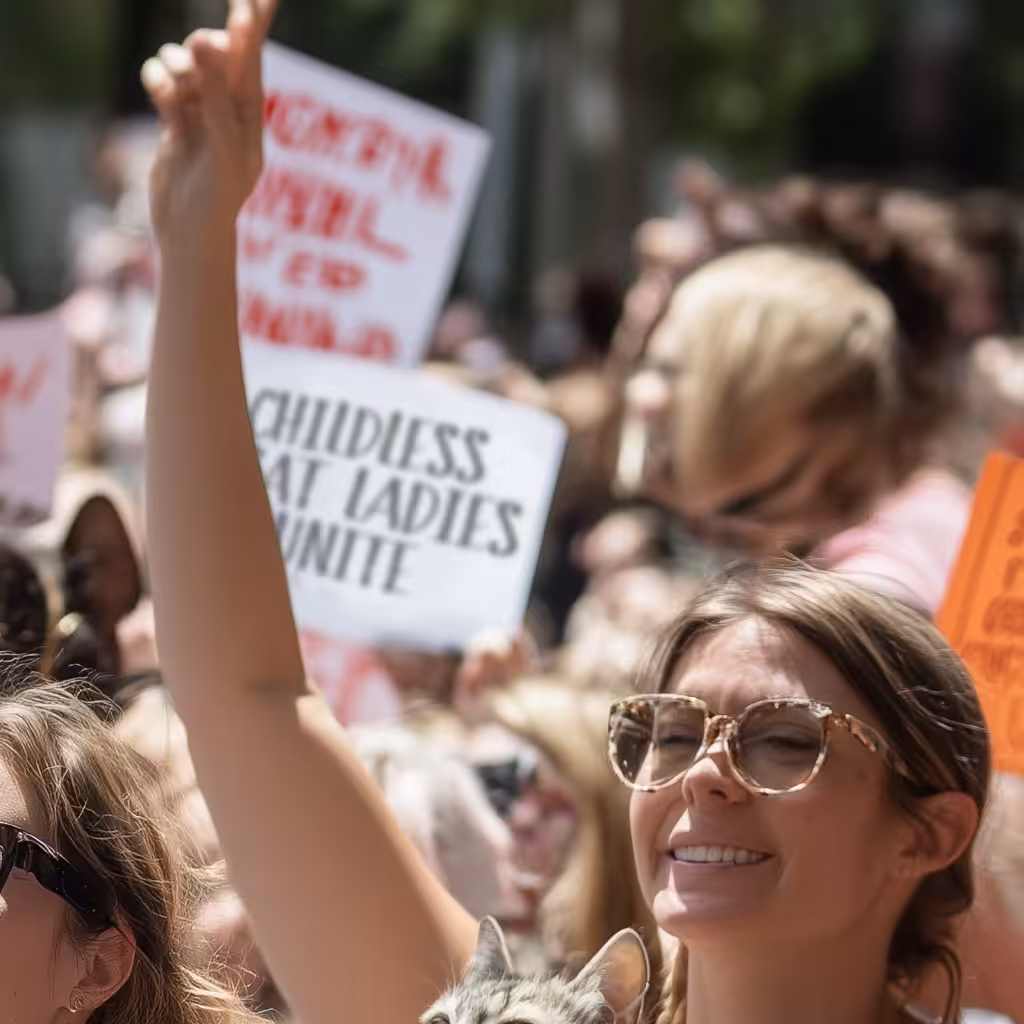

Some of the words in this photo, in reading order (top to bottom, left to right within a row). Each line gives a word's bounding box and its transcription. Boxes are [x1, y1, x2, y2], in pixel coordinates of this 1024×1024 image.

[251, 387, 490, 485] CHILDLESS
[260, 452, 330, 512] AT
[343, 465, 524, 559] LADIES
